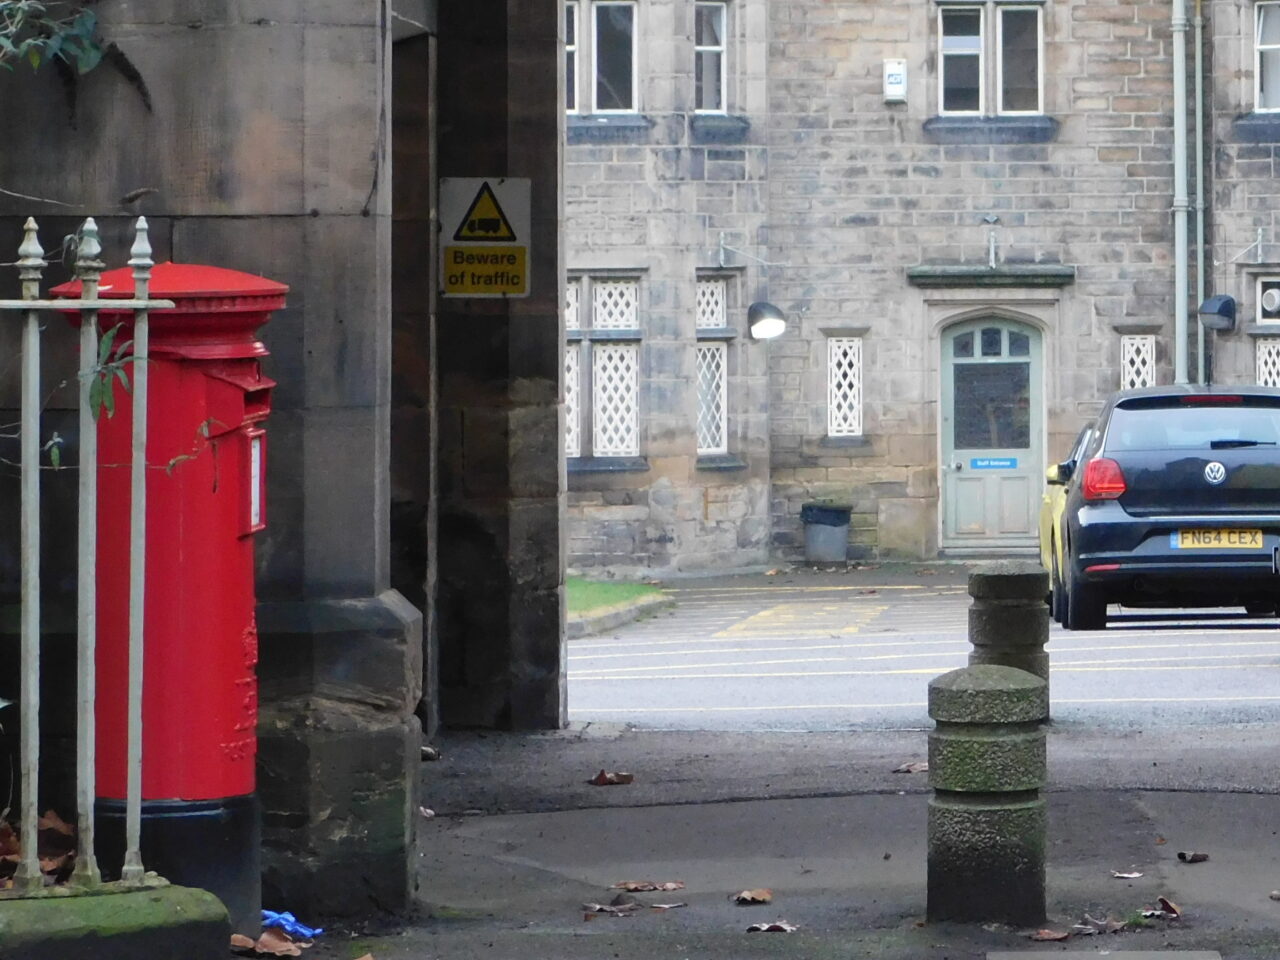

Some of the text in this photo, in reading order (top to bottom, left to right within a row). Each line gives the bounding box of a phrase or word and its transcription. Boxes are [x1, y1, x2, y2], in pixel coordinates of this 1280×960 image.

[453, 250, 517, 265] Beware
[448, 271, 520, 285] of traffic
[1181, 530, 1259, 544] FN64 CEX
